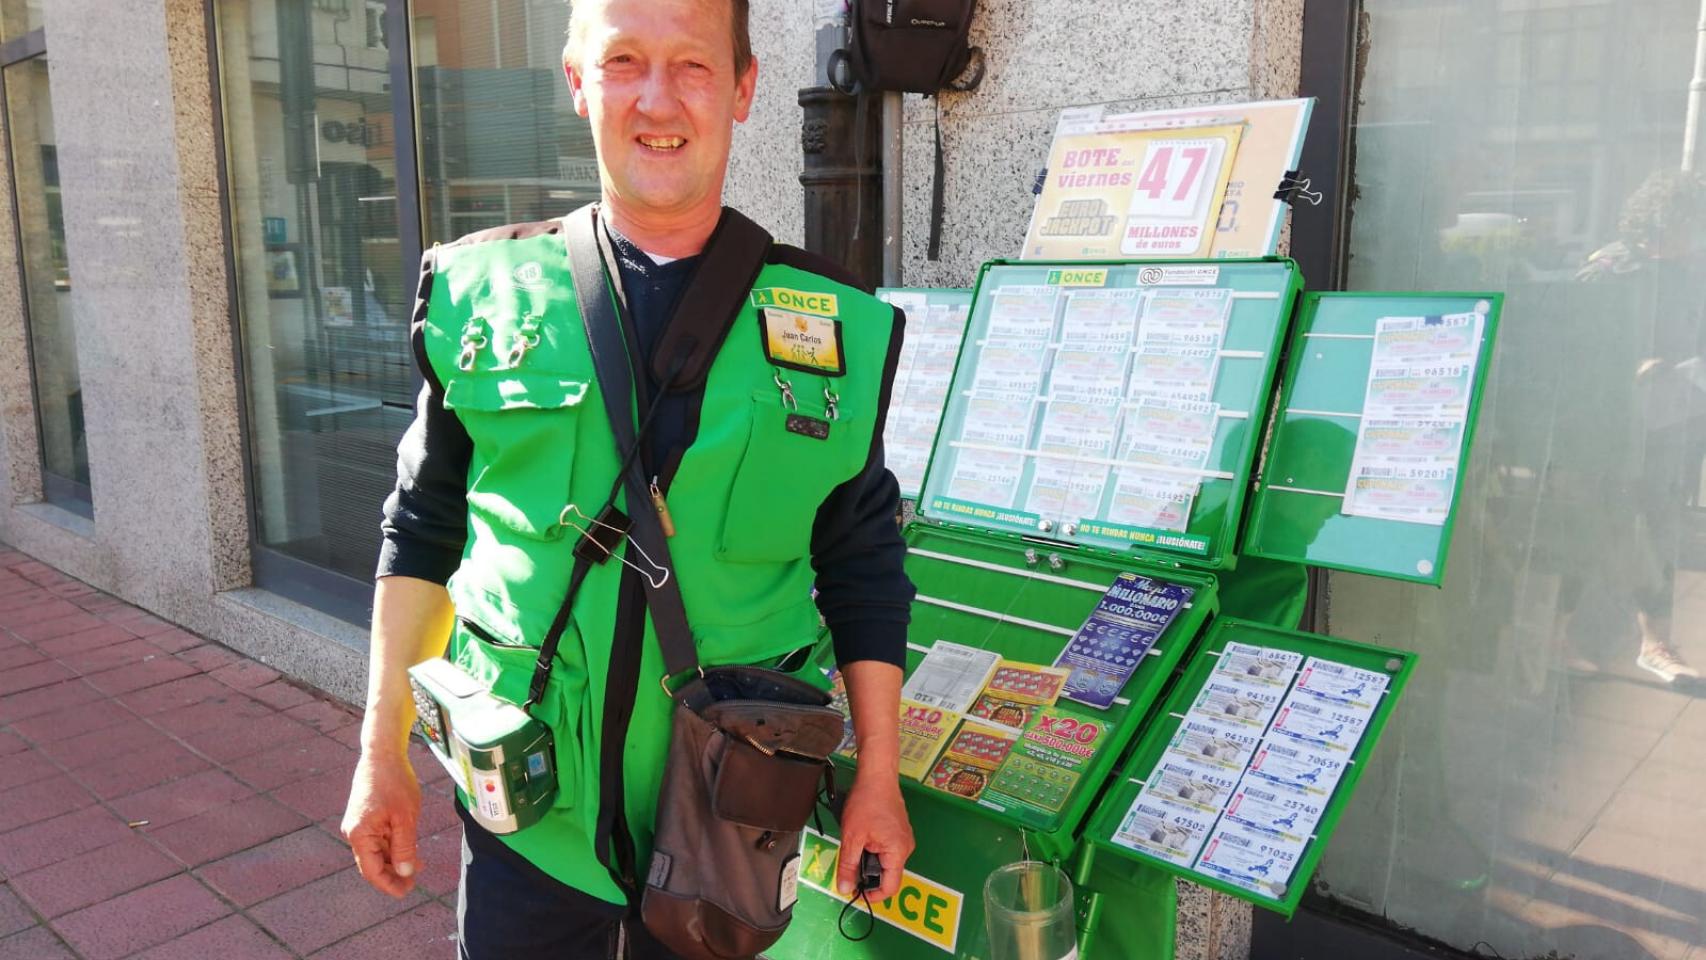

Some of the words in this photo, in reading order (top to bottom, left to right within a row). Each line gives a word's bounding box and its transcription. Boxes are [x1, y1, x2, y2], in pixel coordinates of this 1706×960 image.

[1063, 149, 1121, 168] BOTE
[1058, 171, 1132, 188] viernes
[1137, 147, 1208, 201] 47
[1040, 214, 1115, 236] JACKPOT
[1128, 224, 1198, 239] MILLONES
[1136, 239, 1148, 249] de
[1151, 240, 1182, 249] euros
[1064, 272, 1103, 284] ONCE
[778, 292, 831, 312] ONCE
[782, 330, 798, 342] Juan
[800, 333, 822, 345] Carlos
[1080, 524, 1090, 532] NO
